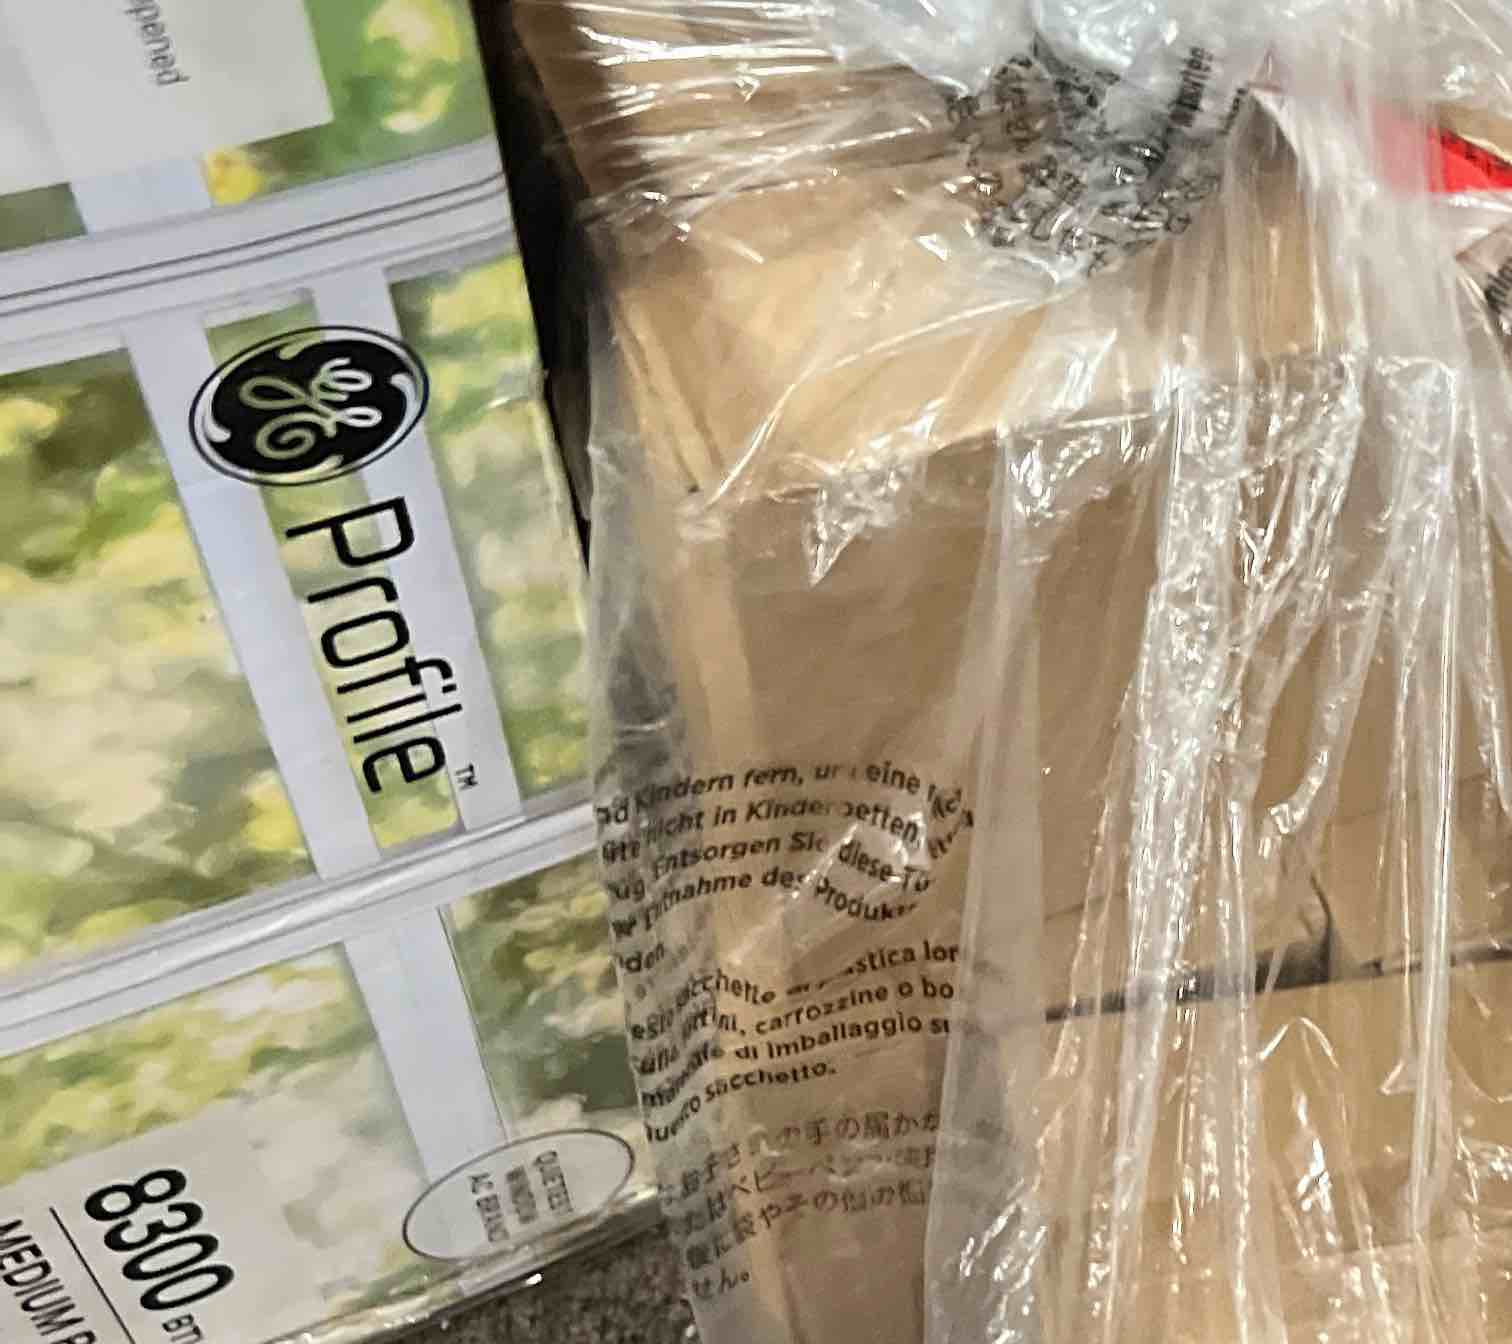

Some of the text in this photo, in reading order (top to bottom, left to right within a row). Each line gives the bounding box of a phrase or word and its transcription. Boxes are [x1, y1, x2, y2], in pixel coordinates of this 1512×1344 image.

[285, 495, 463, 794] Profile
[865, 760, 921, 795] eine
[714, 806, 738, 827] in
[837, 839, 893, 881] diese
[755, 983, 889, 1036] carrozzine
[922, 973, 955, 999] bo
[704, 1063, 837, 1104] sacchetto.
[84, 1168, 235, 1311] 8300
[0, 1219, 85, 1338] MEDIUM
